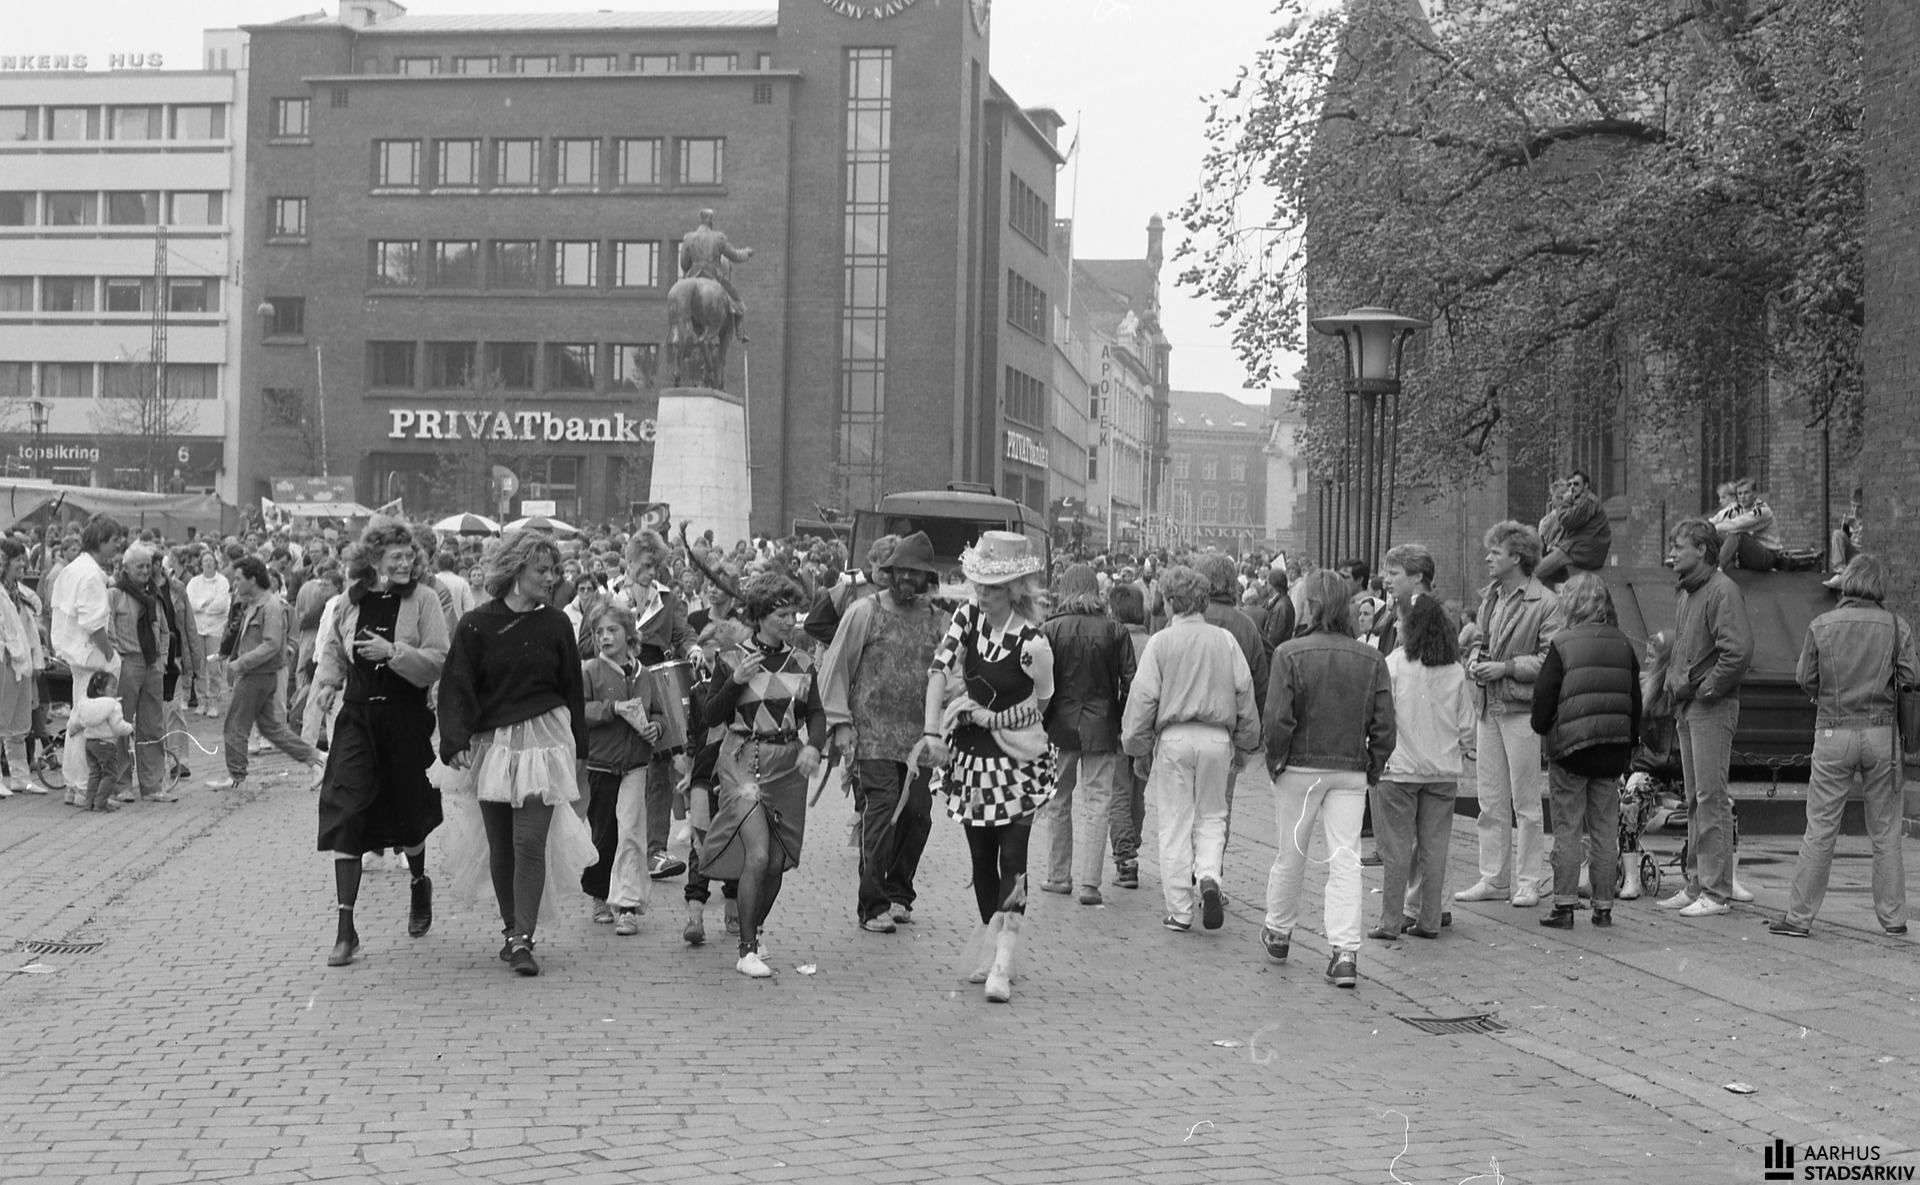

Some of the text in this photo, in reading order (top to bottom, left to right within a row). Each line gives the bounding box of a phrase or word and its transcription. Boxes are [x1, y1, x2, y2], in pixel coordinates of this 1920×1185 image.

[1, 53, 163, 69] NKENS HUS
[1100, 345, 1110, 447] APOTEK
[388, 409, 656, 442] PRIVATbanke
[19, 444, 100, 463] topsikring
[177, 445, 190, 463] 6
